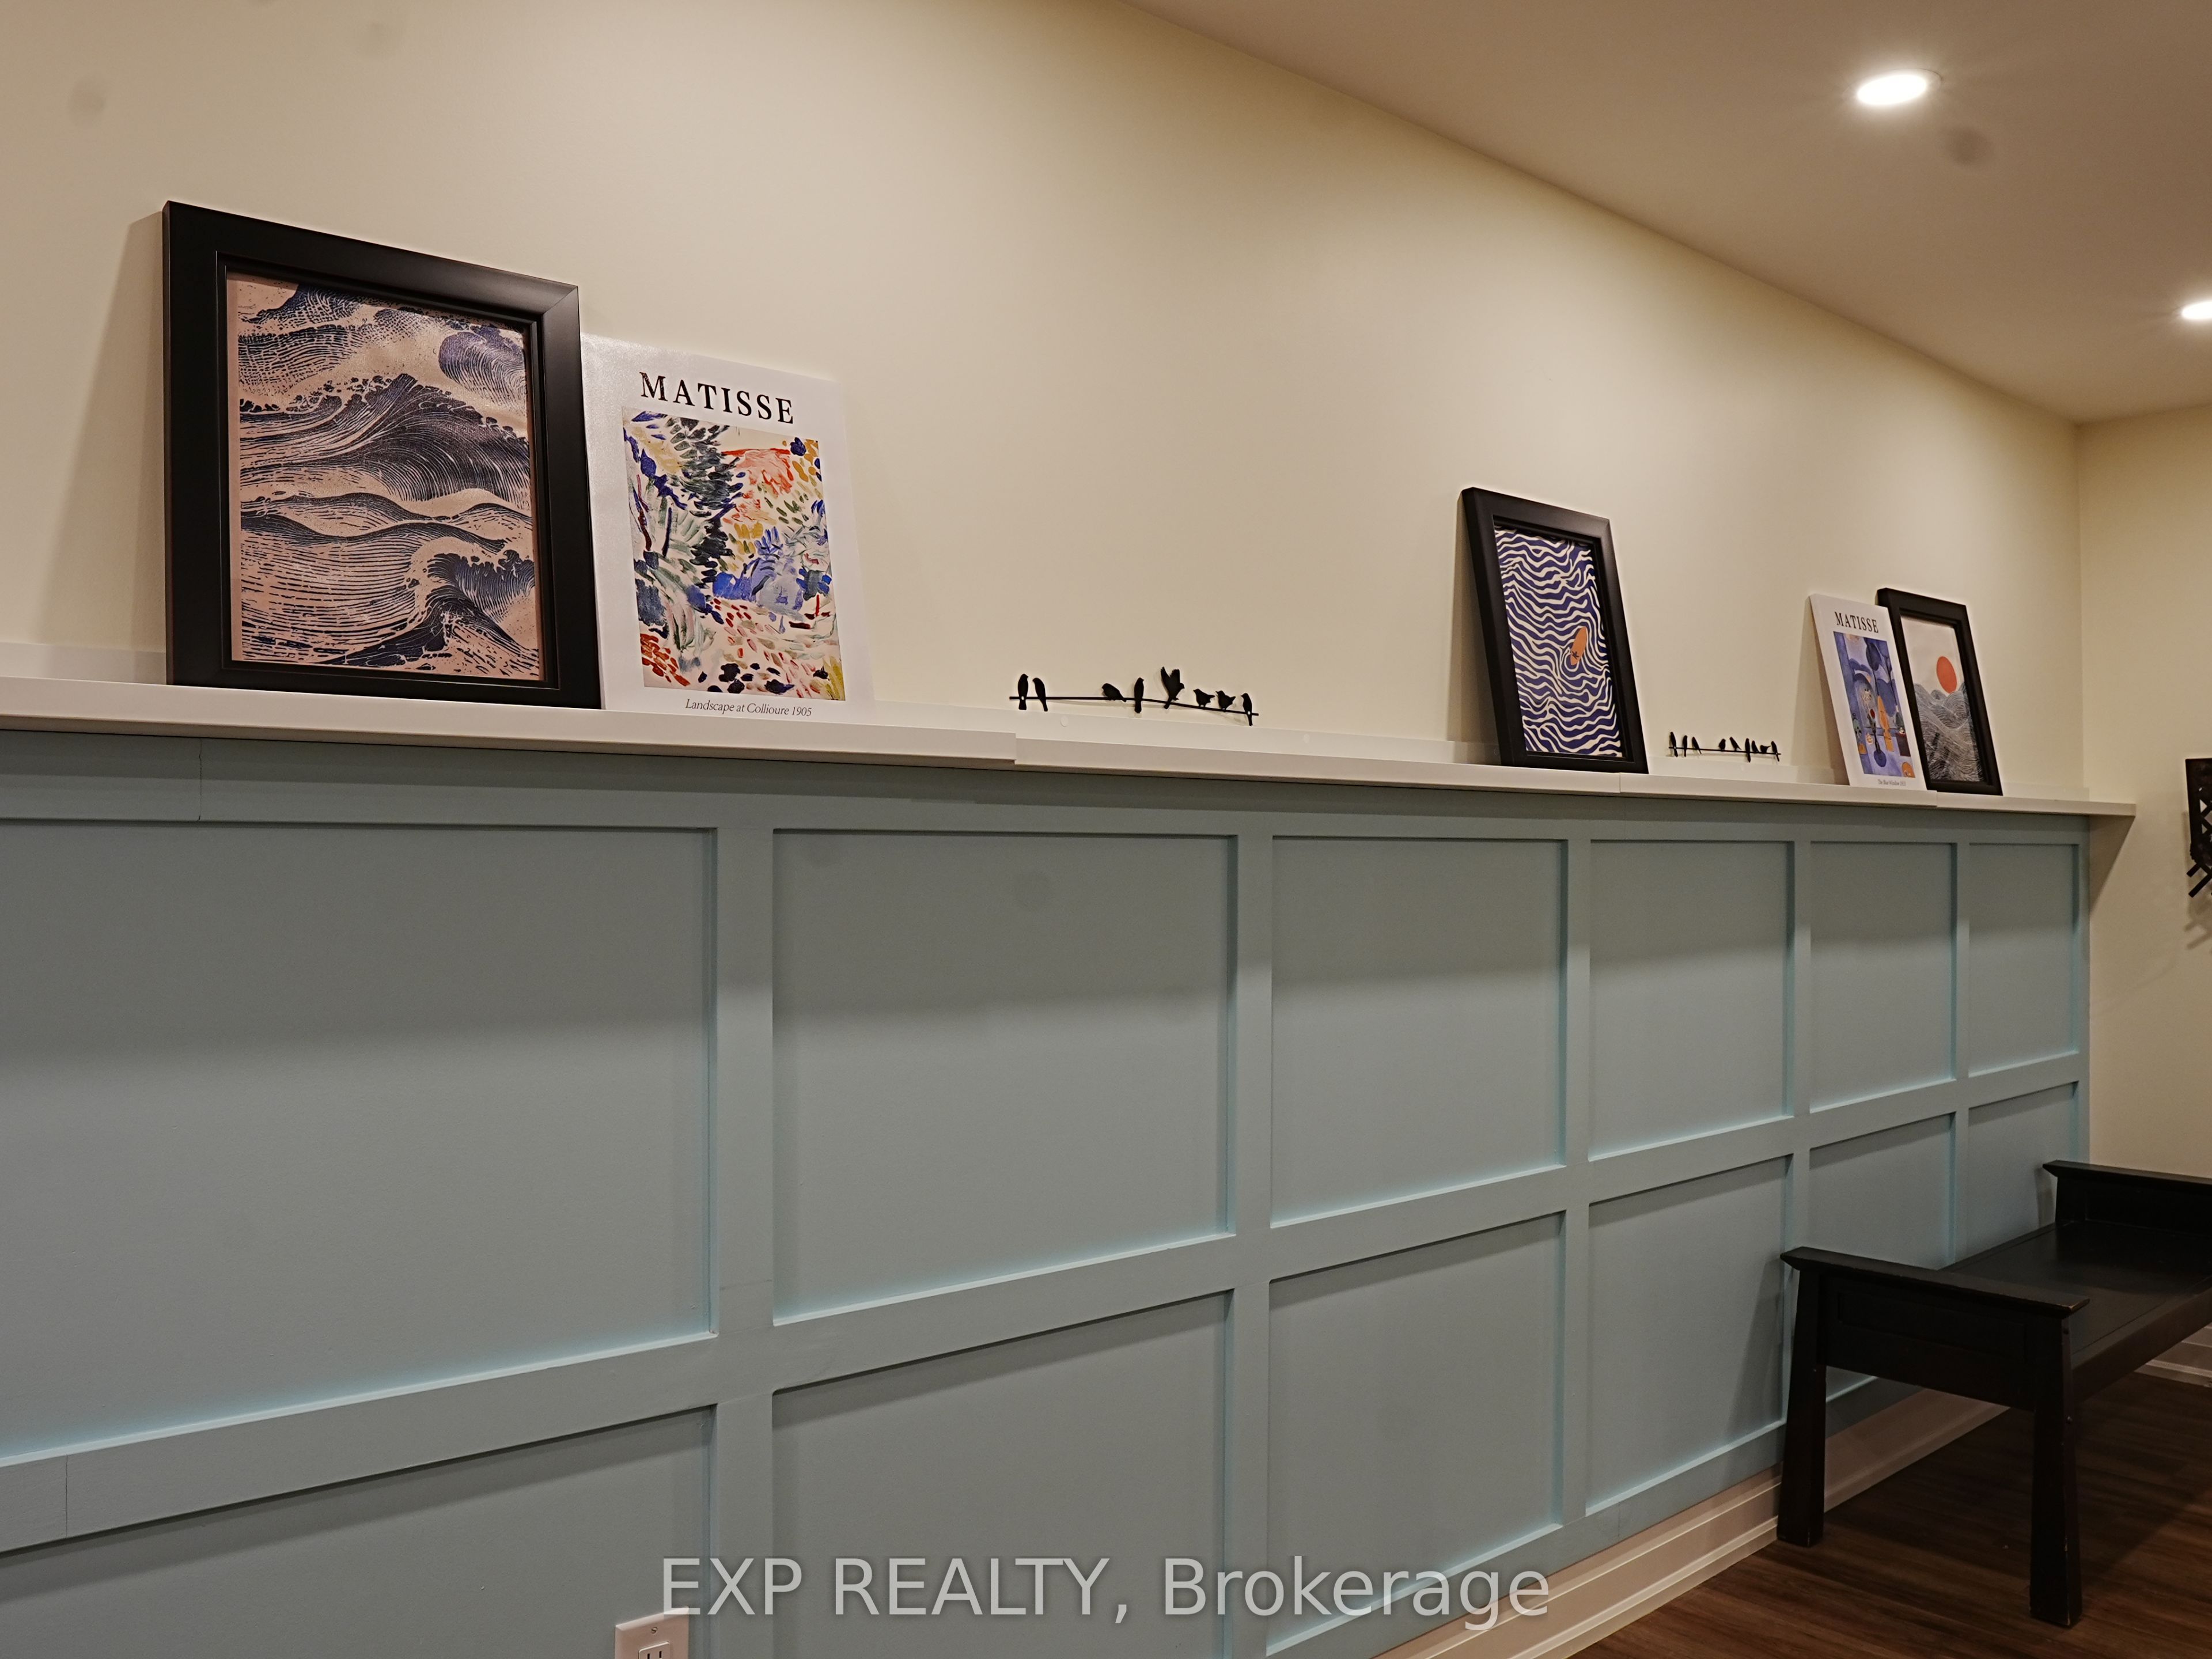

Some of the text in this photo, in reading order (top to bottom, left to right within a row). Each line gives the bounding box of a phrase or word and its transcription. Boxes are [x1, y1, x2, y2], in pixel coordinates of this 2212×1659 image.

[639, 372, 793, 424] MATISSE
[1835, 611, 1878, 633] MATISSE
[685, 699, 812, 717] Landscape at Collioure 1905
